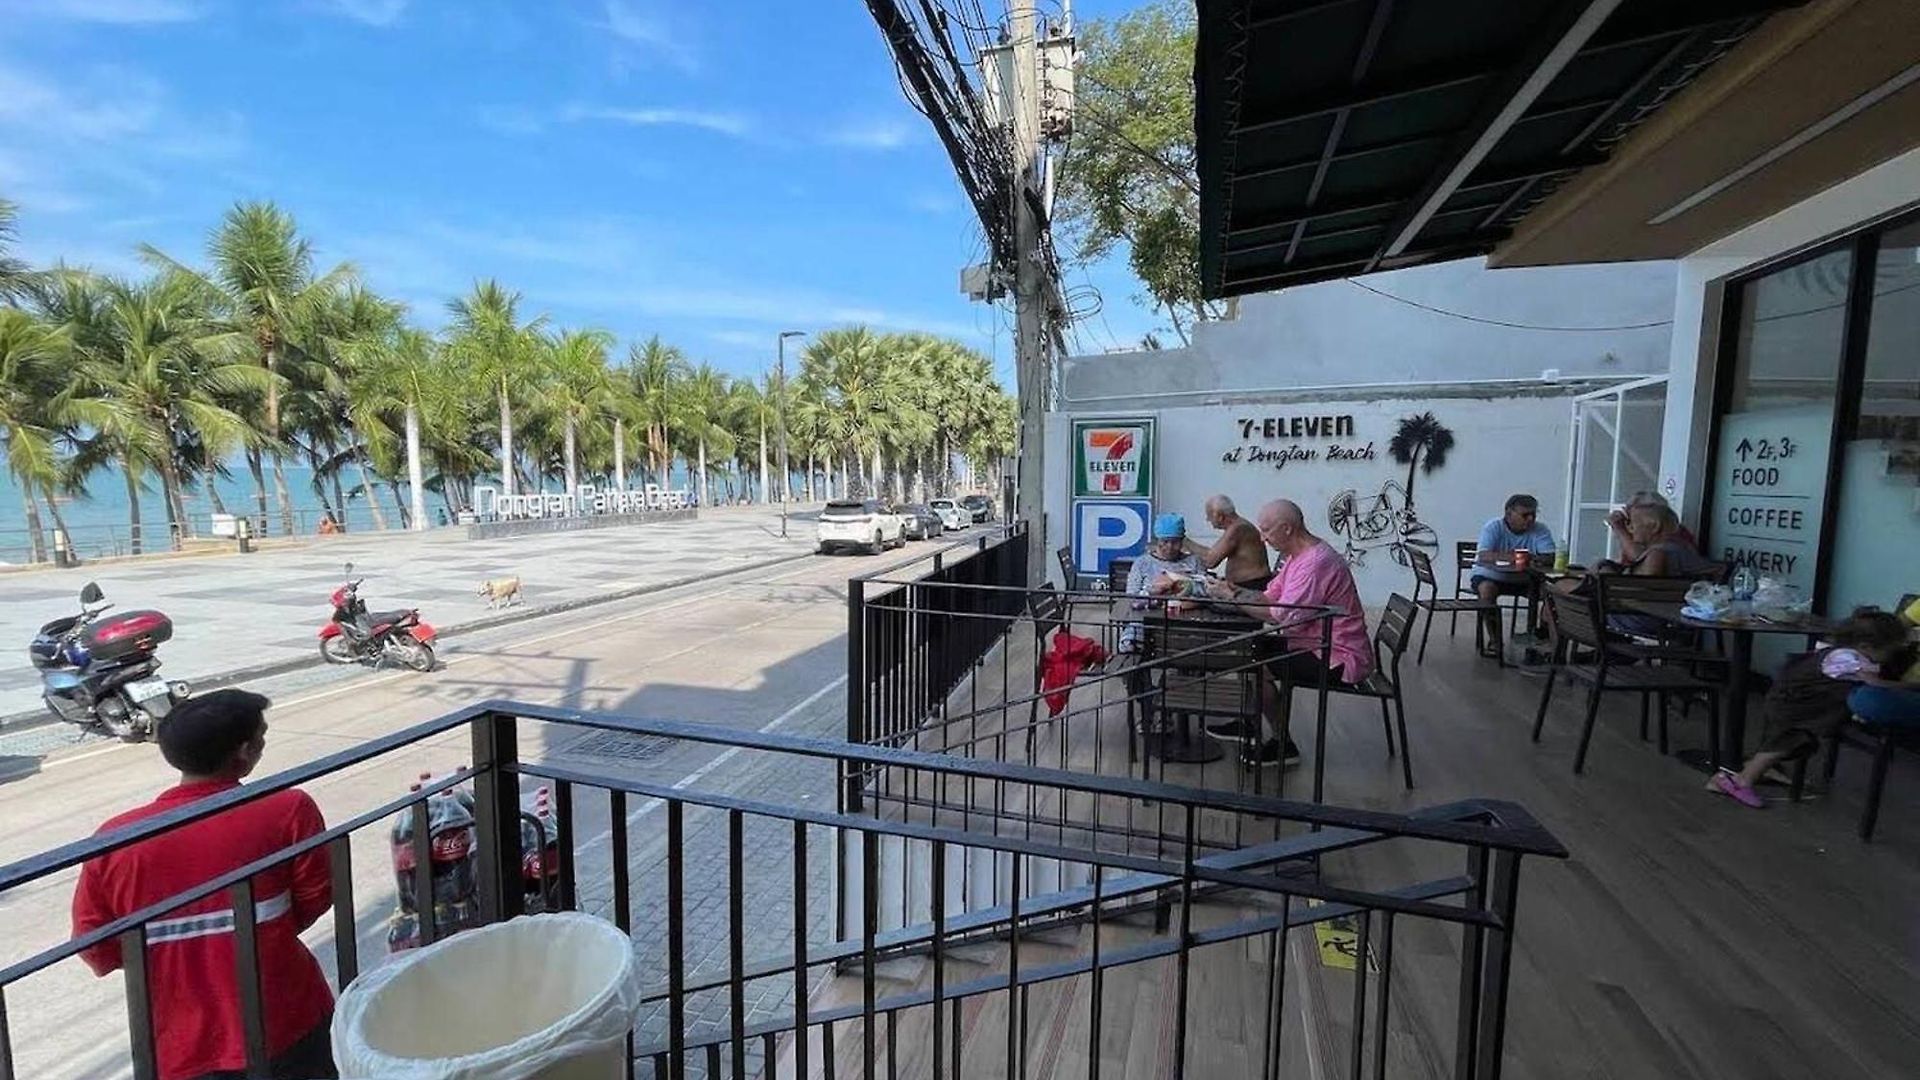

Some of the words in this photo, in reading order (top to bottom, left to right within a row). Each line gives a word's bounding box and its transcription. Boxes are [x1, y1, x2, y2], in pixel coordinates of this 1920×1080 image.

[1222, 447, 1241, 462] at
[1247, 444, 1318, 470] Dongtan
[1325, 441, 1375, 461] Beach
[1732, 468, 1779, 486] FOOD
[1728, 507, 1803, 530] COFFEE
[1080, 504, 1143, 572] P
[1724, 547, 1797, 574] BAKERY
